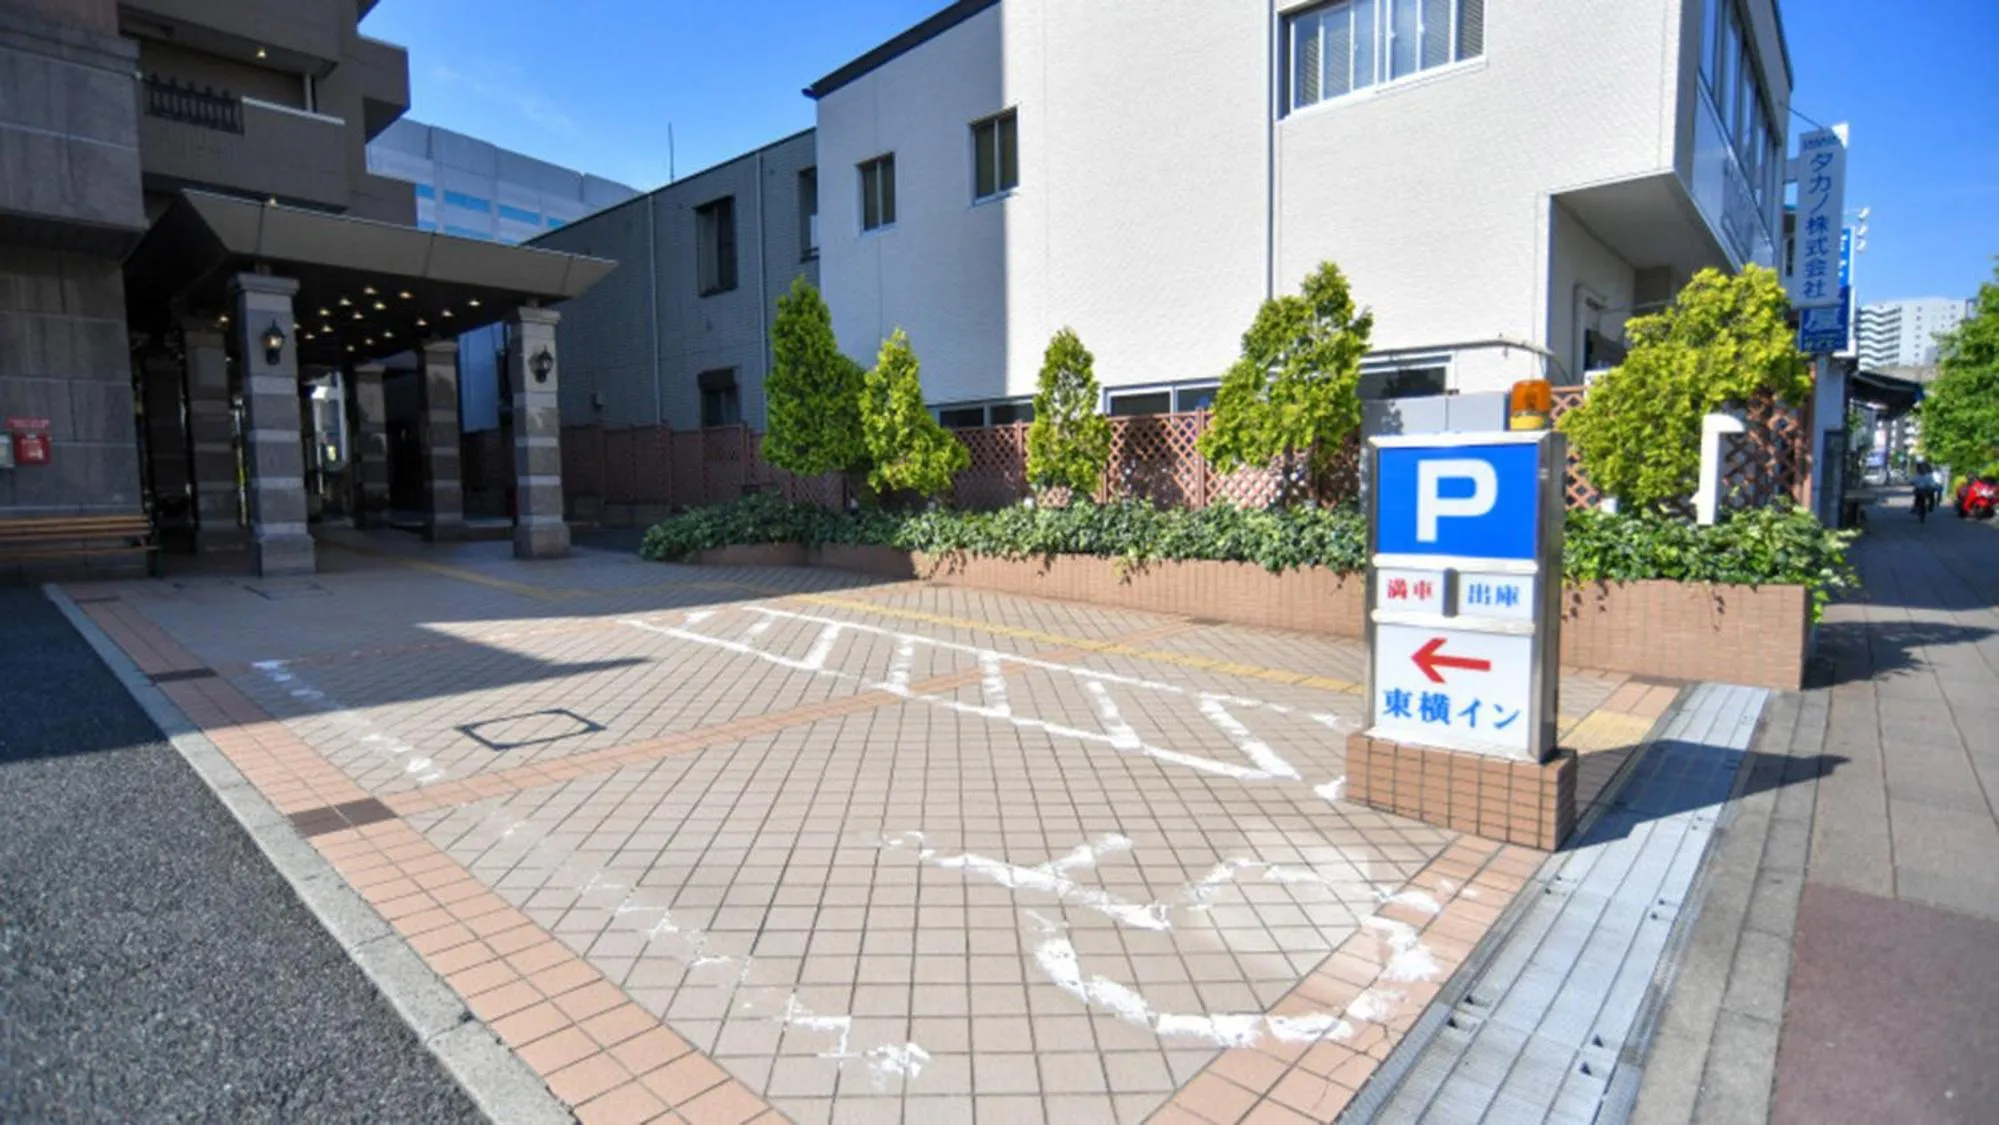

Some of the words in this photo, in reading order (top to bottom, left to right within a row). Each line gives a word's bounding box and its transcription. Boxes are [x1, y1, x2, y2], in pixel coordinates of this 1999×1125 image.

[1803, 152, 1834, 298] タカノ株式会社
[1416, 458, 1497, 542] P
[1387, 578, 1433, 600] 満車
[1468, 583, 1519, 607] 出庫
[1383, 688, 1521, 729] 東横イン
